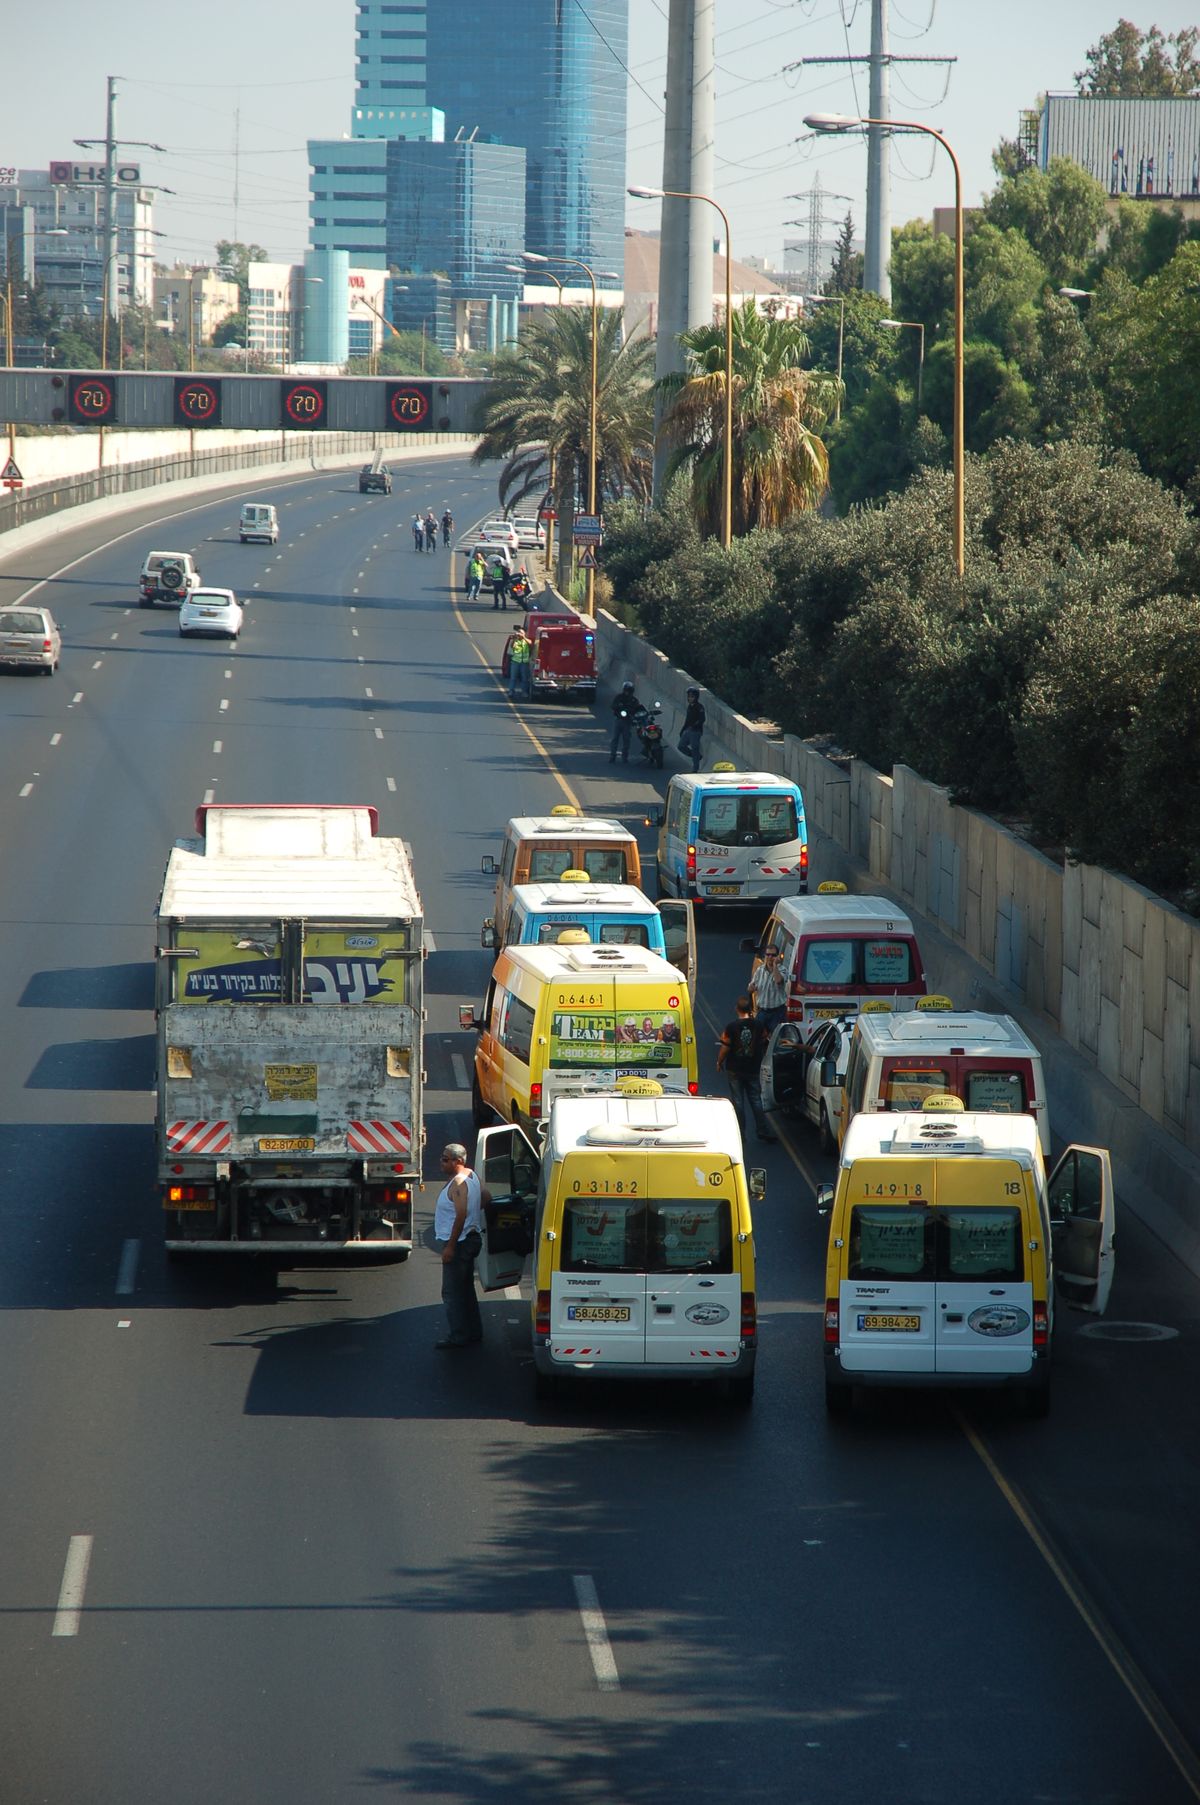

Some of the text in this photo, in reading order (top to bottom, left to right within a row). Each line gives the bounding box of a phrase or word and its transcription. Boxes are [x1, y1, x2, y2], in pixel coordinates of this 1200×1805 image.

[81, 390, 104, 407] 70
[187, 392, 209, 409] 70
[294, 395, 316, 412] 70
[398, 397, 421, 414] 70
[886, 922, 894, 931] 13
[669, 998, 678, 1006] 46
[556, 1015, 604, 1040] TEAM
[710, 1175, 722, 1184] 10
[1004, 1182, 1021, 1195] 18
